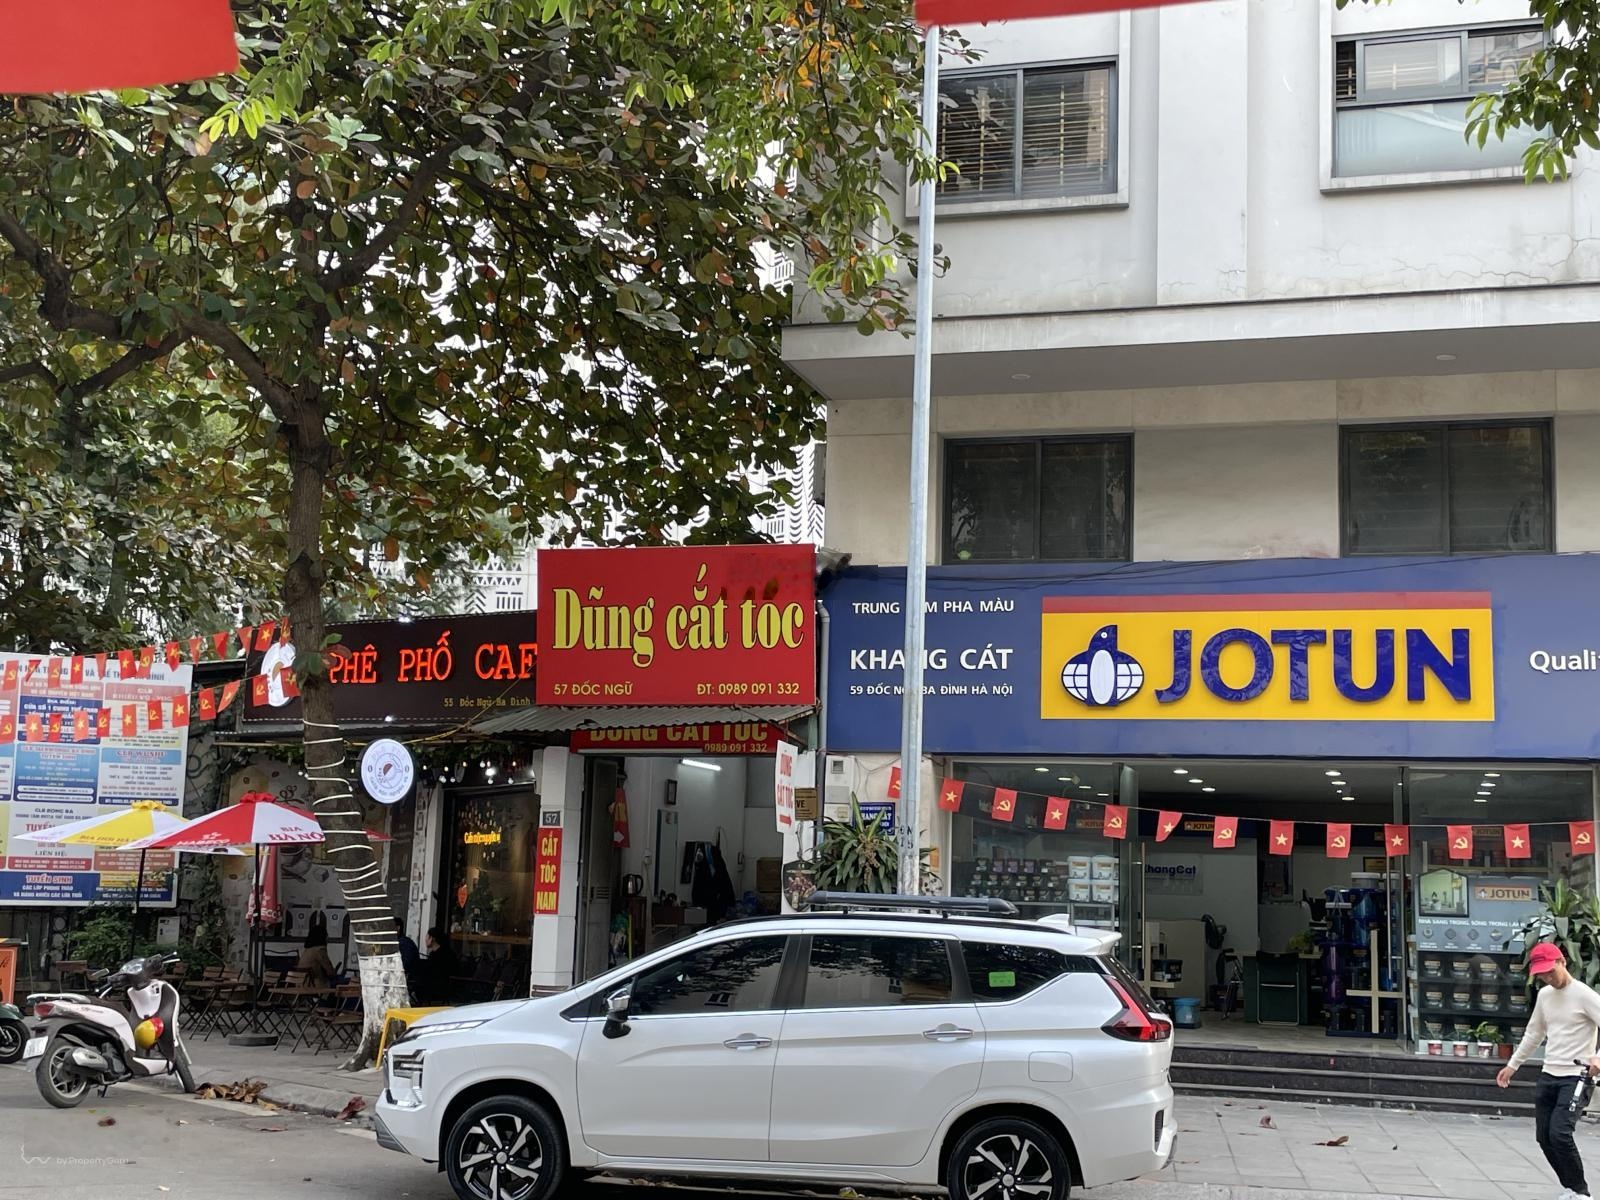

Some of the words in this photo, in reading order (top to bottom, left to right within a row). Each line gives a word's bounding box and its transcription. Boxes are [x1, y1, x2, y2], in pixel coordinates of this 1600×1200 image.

[852, 602, 900, 614] TRUNG
[943, 601, 973, 612] PHA
[980, 597, 1014, 612] MÀU
[552, 586, 655, 668] Dũng
[665, 562, 729, 650] cắt
[397, 630, 452, 682] PHỐ
[960, 643, 1013, 669] CÁT
[1529, 648, 1600, 673] Quali
[1155, 628, 1471, 704] JOTUN
[553, 684, 568, 695] 57
[572, 680, 600, 695] ĐỐC
[604, 680, 633, 695] NGỮ
[696, 682, 715, 695] ĐT:
[718, 683, 748, 695] 0989
[751, 683, 773, 695] 091
[777, 682, 800, 695] 332
[850, 685, 863, 695] 59
[866, 682, 890, 695] ĐỐC
[940, 683, 967, 695] ĐÌNH
[971, 683, 988, 695] HÀ
[992, 683, 1013, 697] NỘI
[443, 697, 454, 707] 55
[729, 743, 746, 752] 091
[750, 743, 767, 752] 332
[545, 813, 558, 824] 57
[540, 860, 556, 884] TÓC
[536, 891, 556, 910] NAM
[1490, 889, 1530, 899] JOTUN
